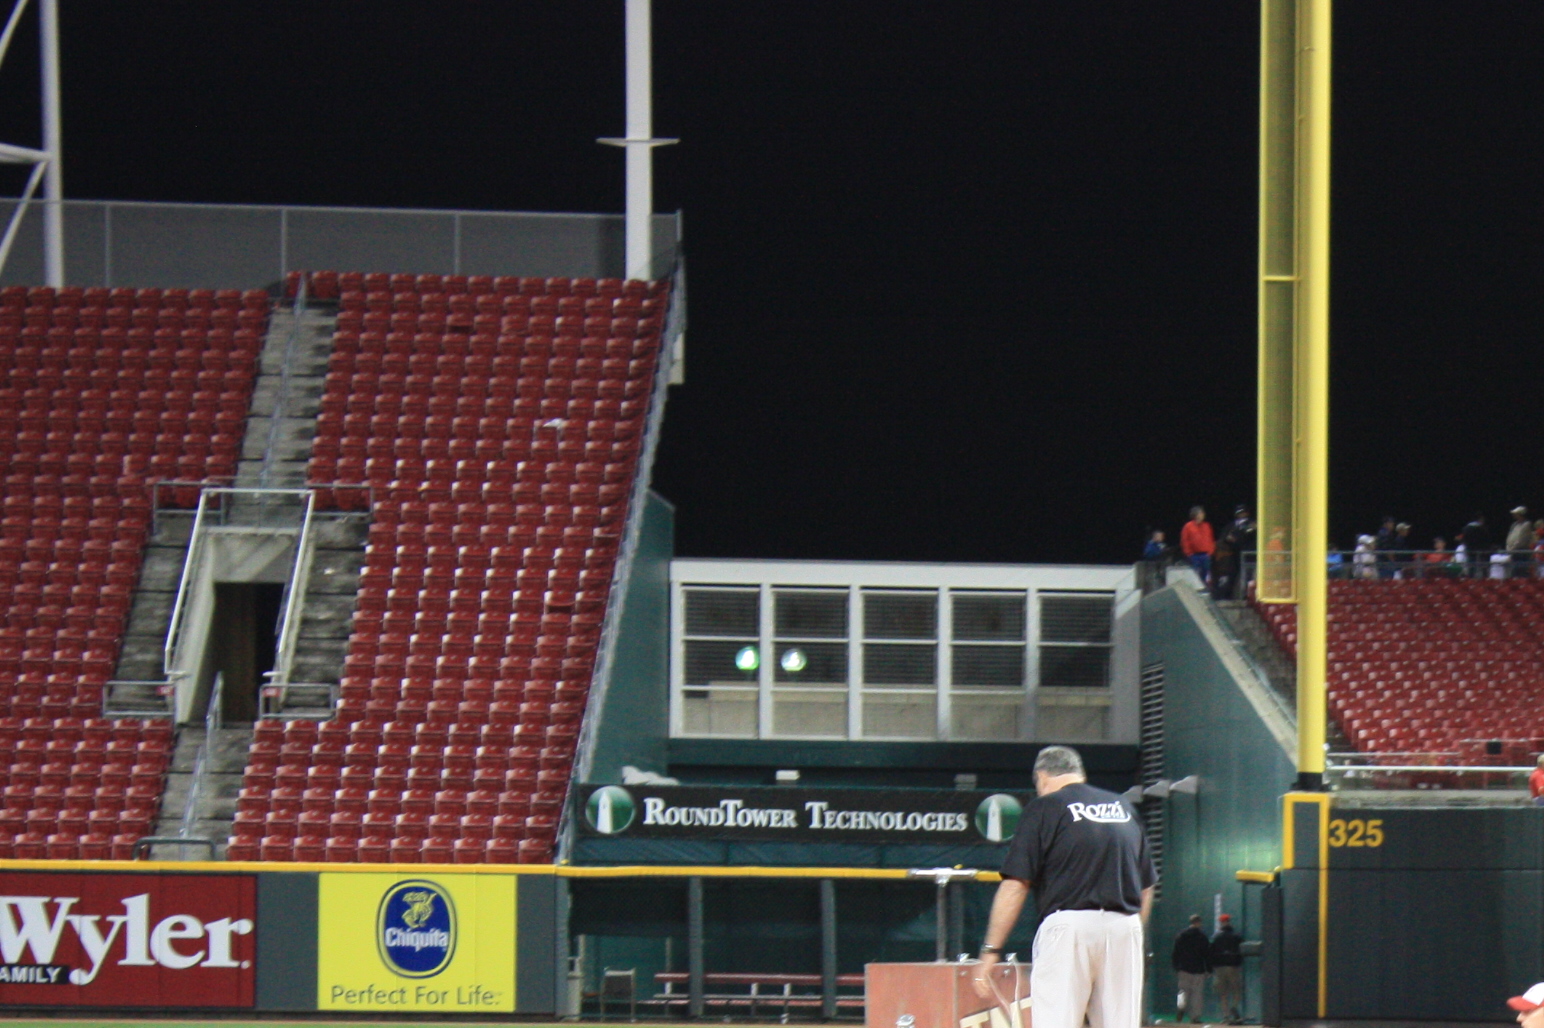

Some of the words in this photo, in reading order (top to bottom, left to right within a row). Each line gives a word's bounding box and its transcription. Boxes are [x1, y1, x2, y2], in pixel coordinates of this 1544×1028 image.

[1066, 801, 1131, 823] Rozzi
[1328, 818, 1384, 848] 325
[385, 927, 448, 952] Chiquita
[331, 984, 406, 1005] Perfect
[415, 985, 449, 1005] For
